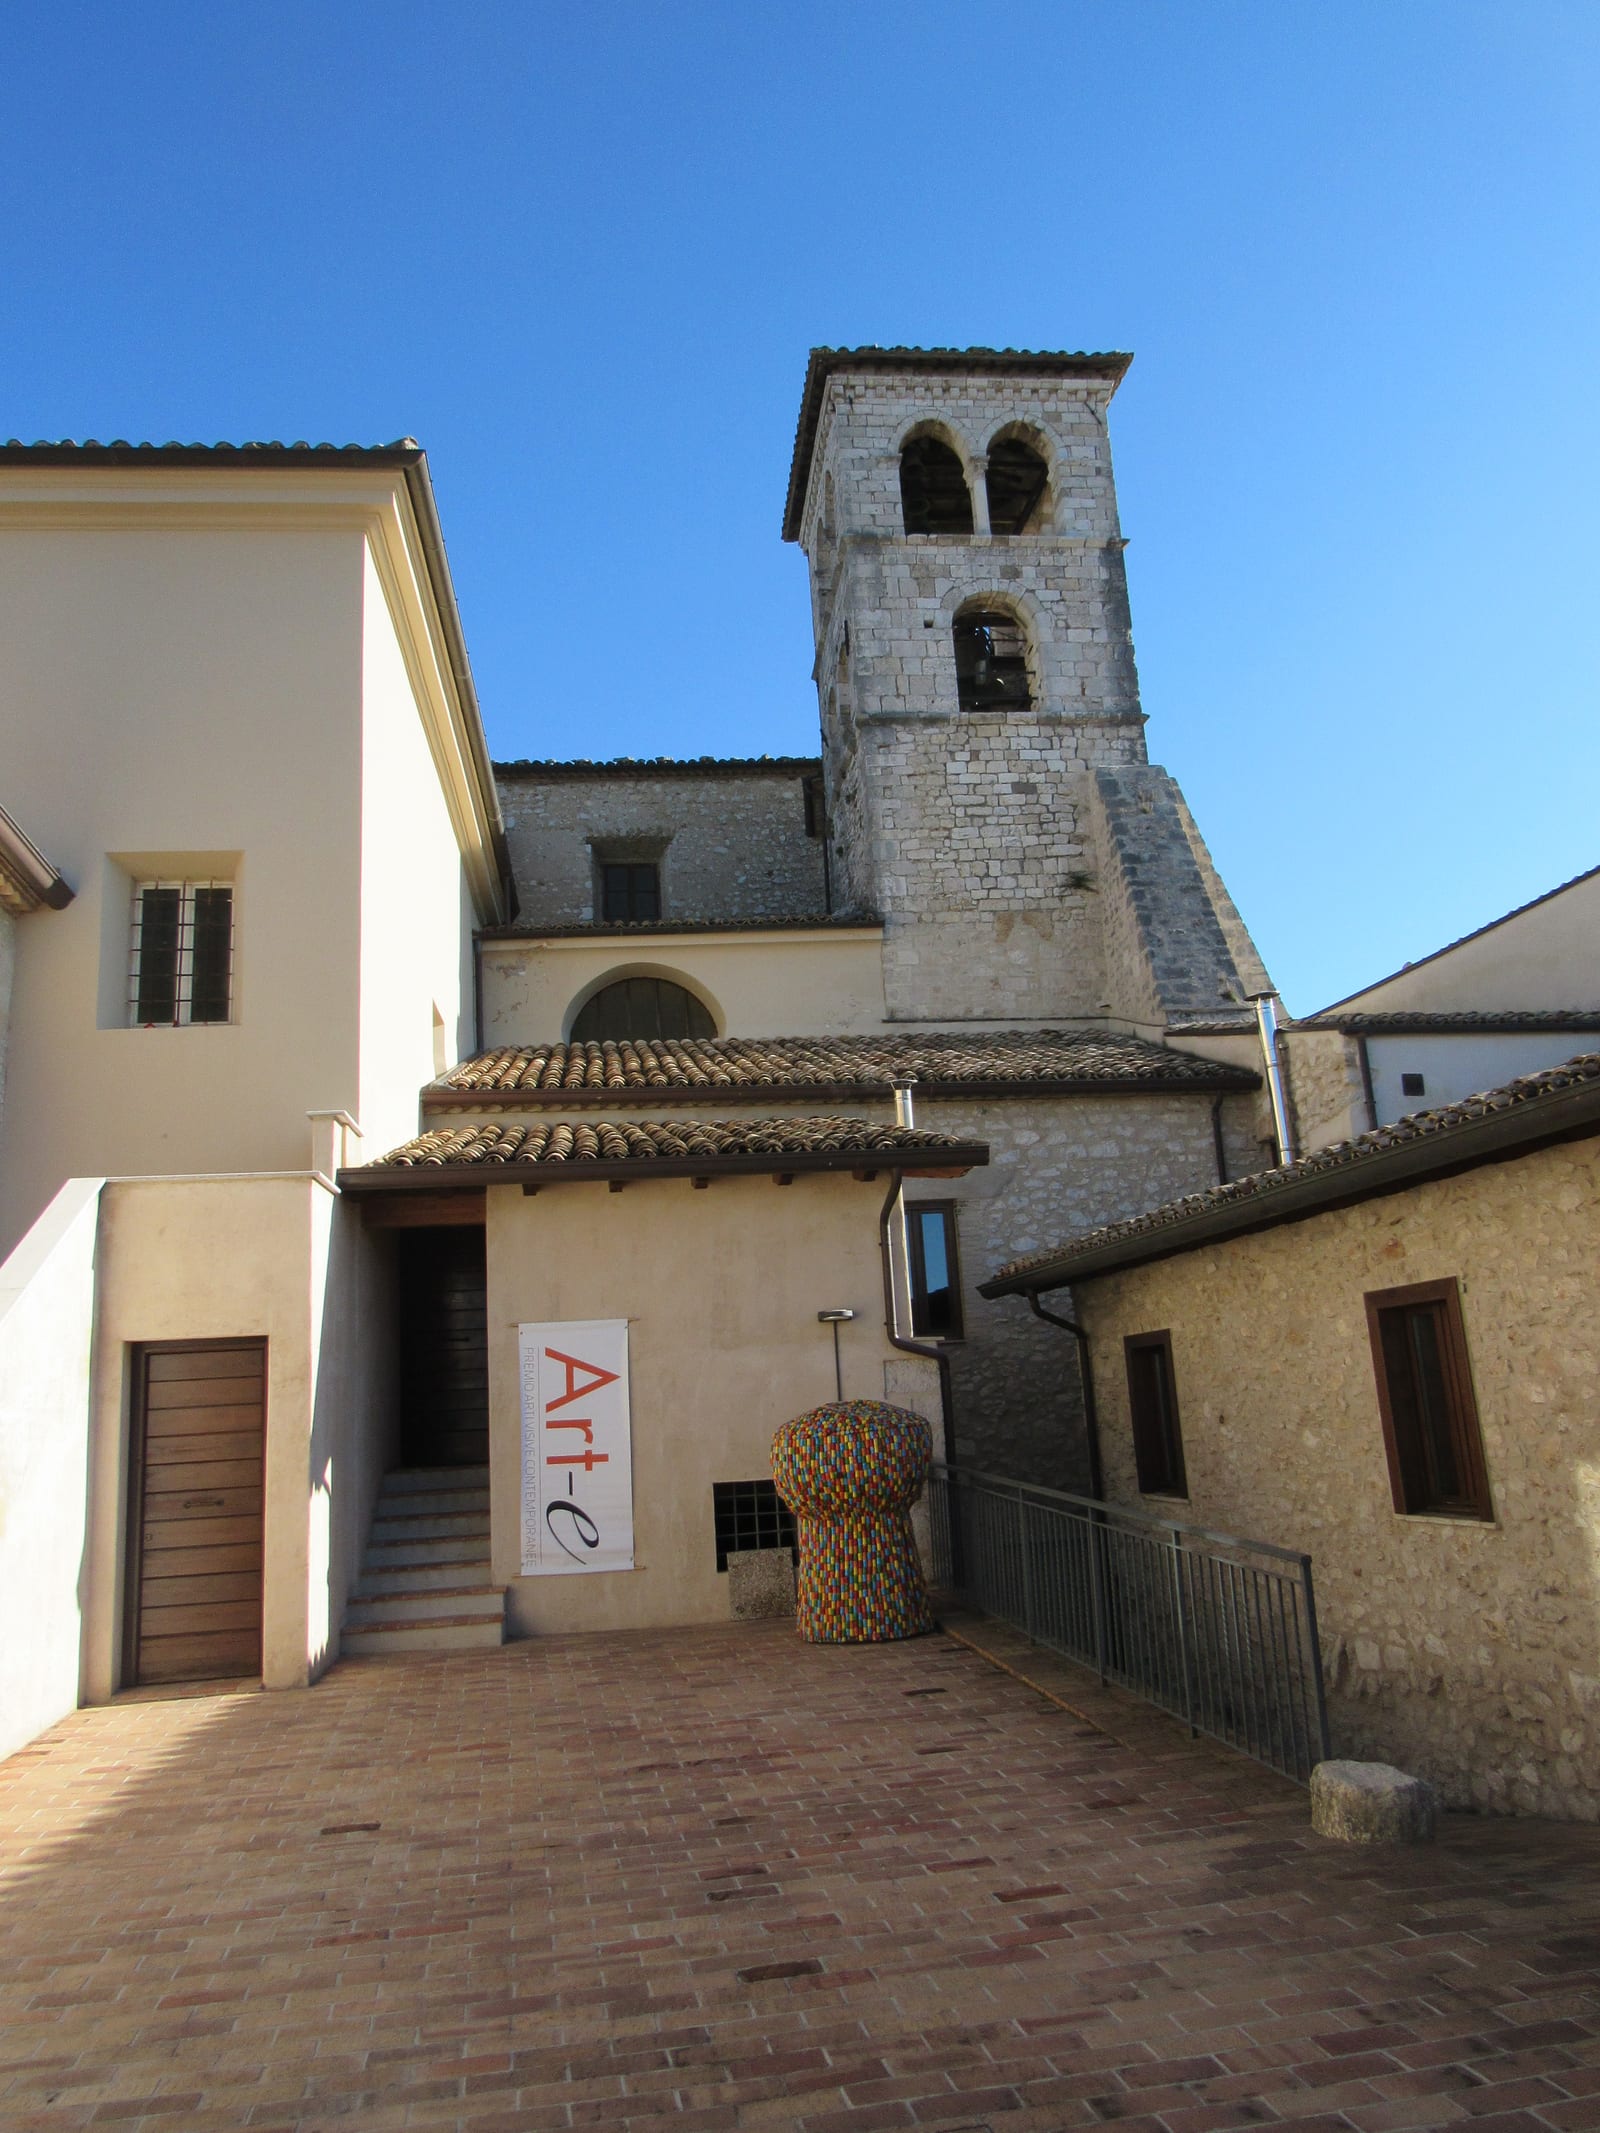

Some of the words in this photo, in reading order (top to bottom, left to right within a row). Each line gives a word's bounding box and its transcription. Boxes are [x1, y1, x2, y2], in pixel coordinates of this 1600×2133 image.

[524, 1347, 535, 1392] PREMIO
[524, 1394, 535, 1420] ARTI
[524, 1421, 536, 1459] VISIVE
[545, 1346, 621, 1565] Art-e
[524, 1460, 537, 1568] CONTEMPORANEE
